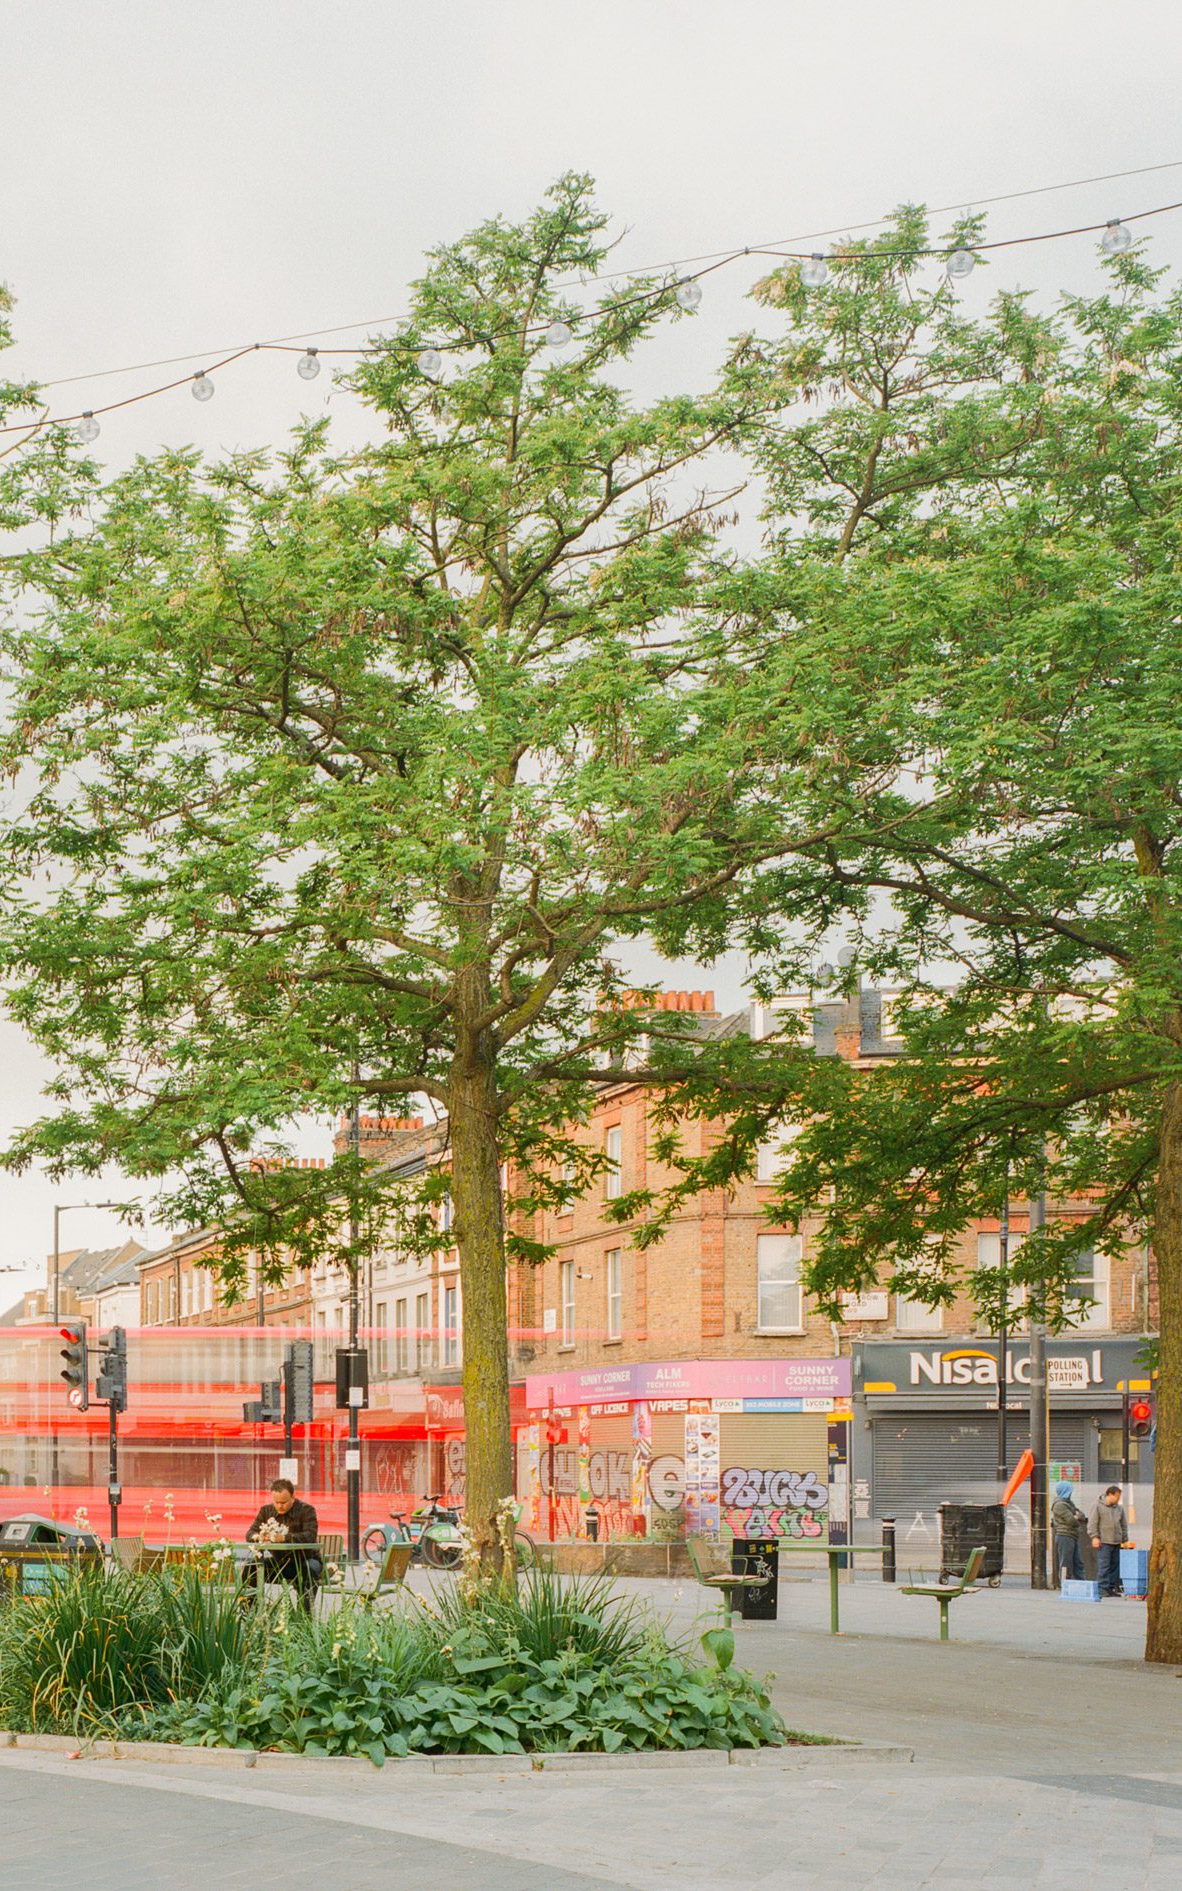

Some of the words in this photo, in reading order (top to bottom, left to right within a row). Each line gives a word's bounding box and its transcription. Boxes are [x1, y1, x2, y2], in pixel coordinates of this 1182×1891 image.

[1048, 1360, 1083, 1370] POLLING
[655, 1368, 682, 1380] ALM
[789, 1366, 834, 1375] SUNNY
[580, 1374, 603, 1386] SUNNY
[603, 1371, 631, 1384] CORNER
[785, 1375, 839, 1385] CORNER
[1048, 1372, 1083, 1382] STATION
[649, 1400, 688, 1412] VAPES
[806, 1400, 824, 1408] Lyca
[591, 1404, 602, 1415] OFF
